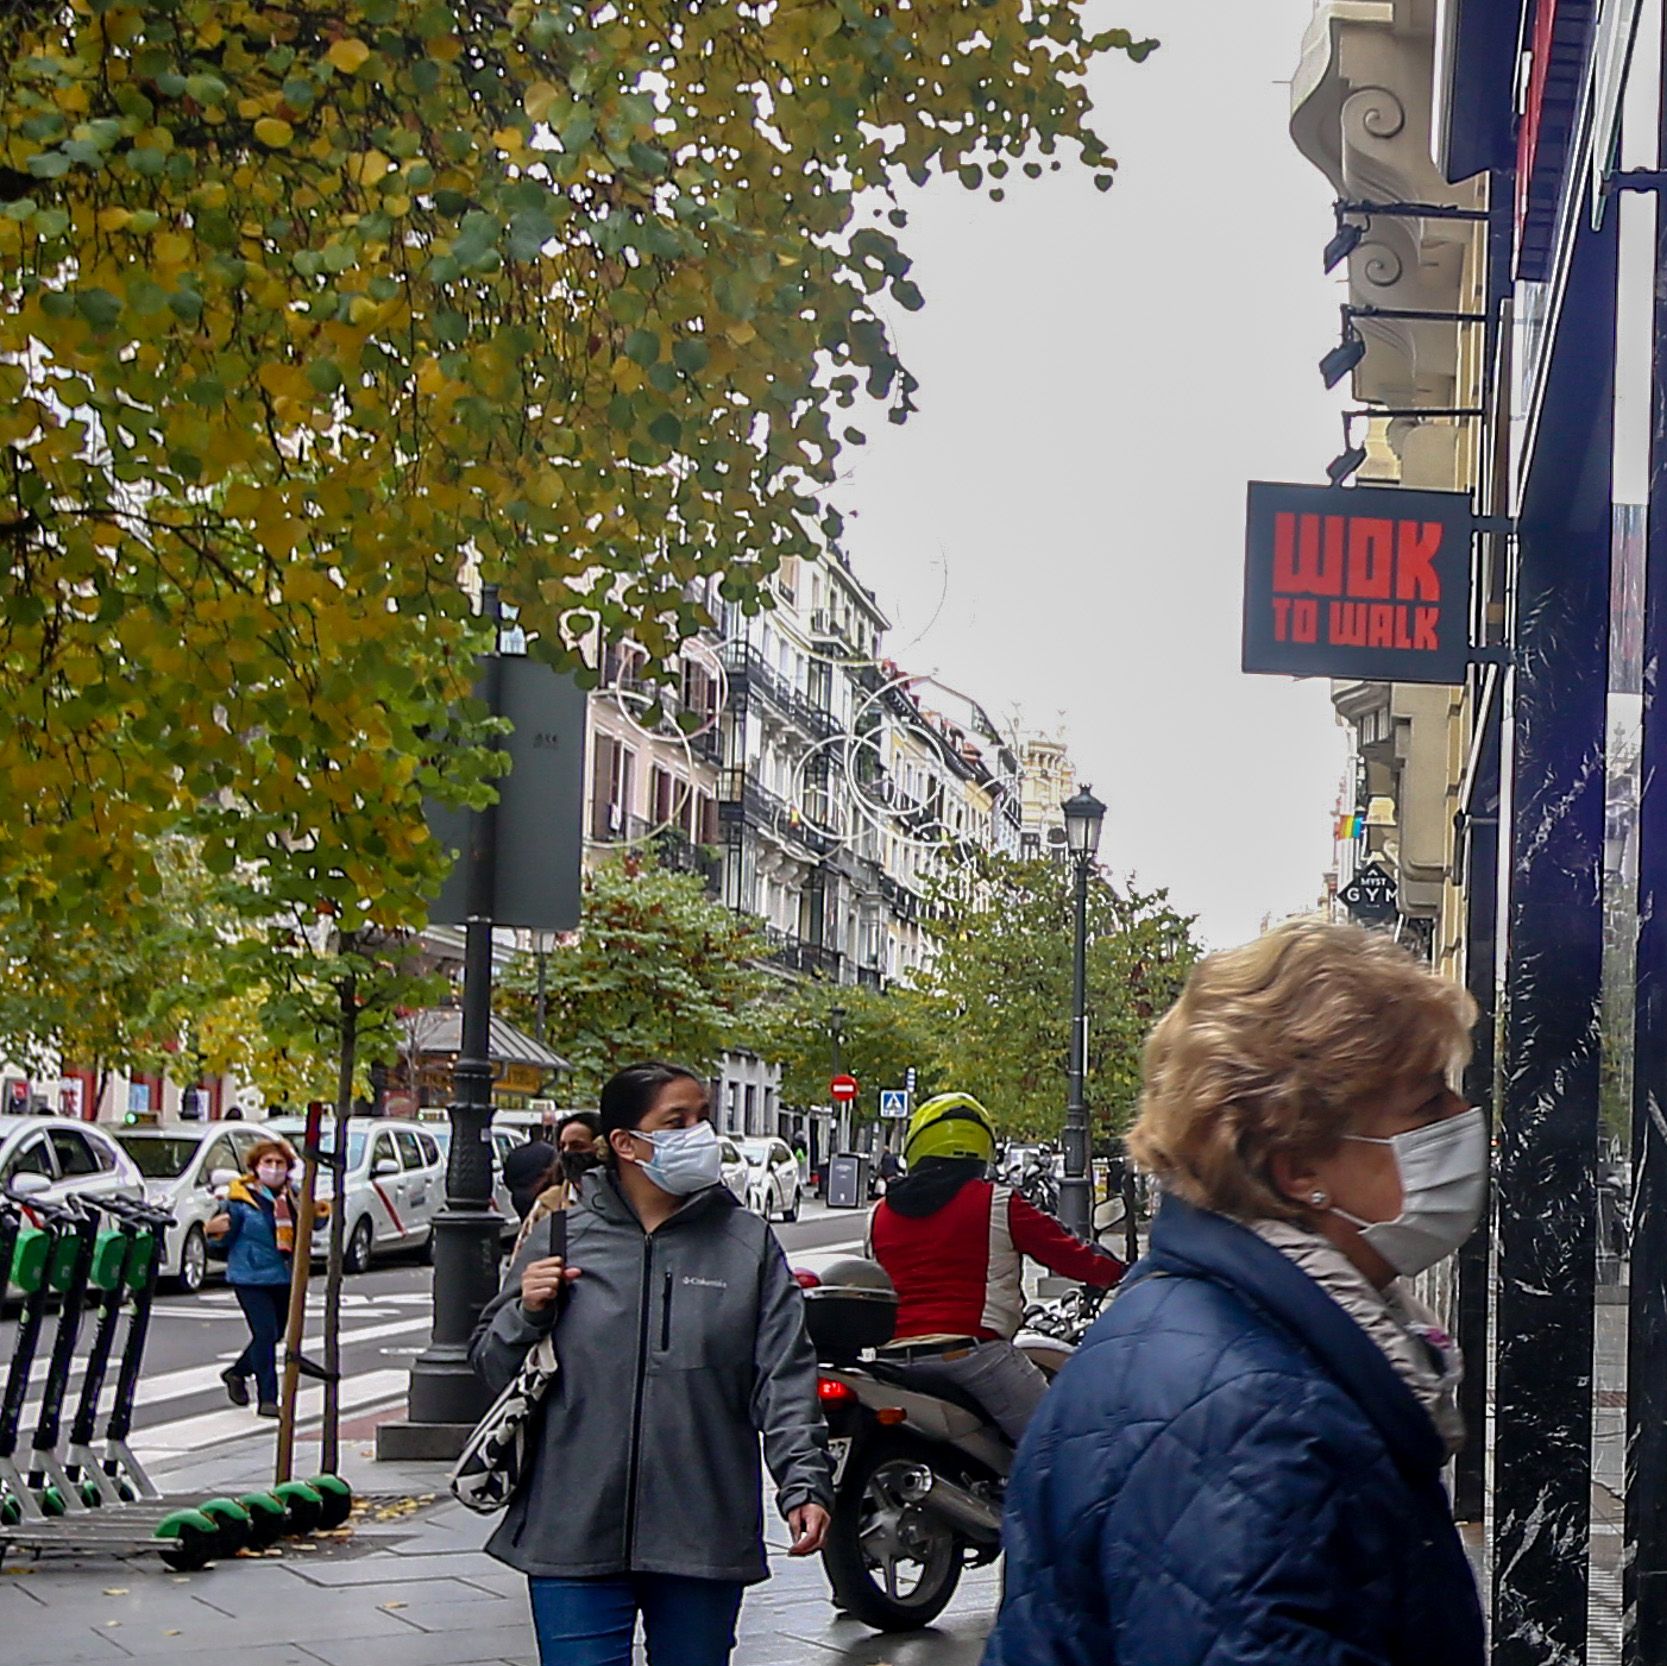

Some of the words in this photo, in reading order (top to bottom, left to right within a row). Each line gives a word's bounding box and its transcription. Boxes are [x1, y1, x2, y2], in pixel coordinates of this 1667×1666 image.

[1272, 512, 1443, 602] WOK
[1272, 597, 1317, 644] TO
[1328, 601, 1440, 651] WALK
[1346, 887, 1398, 902] GYM
